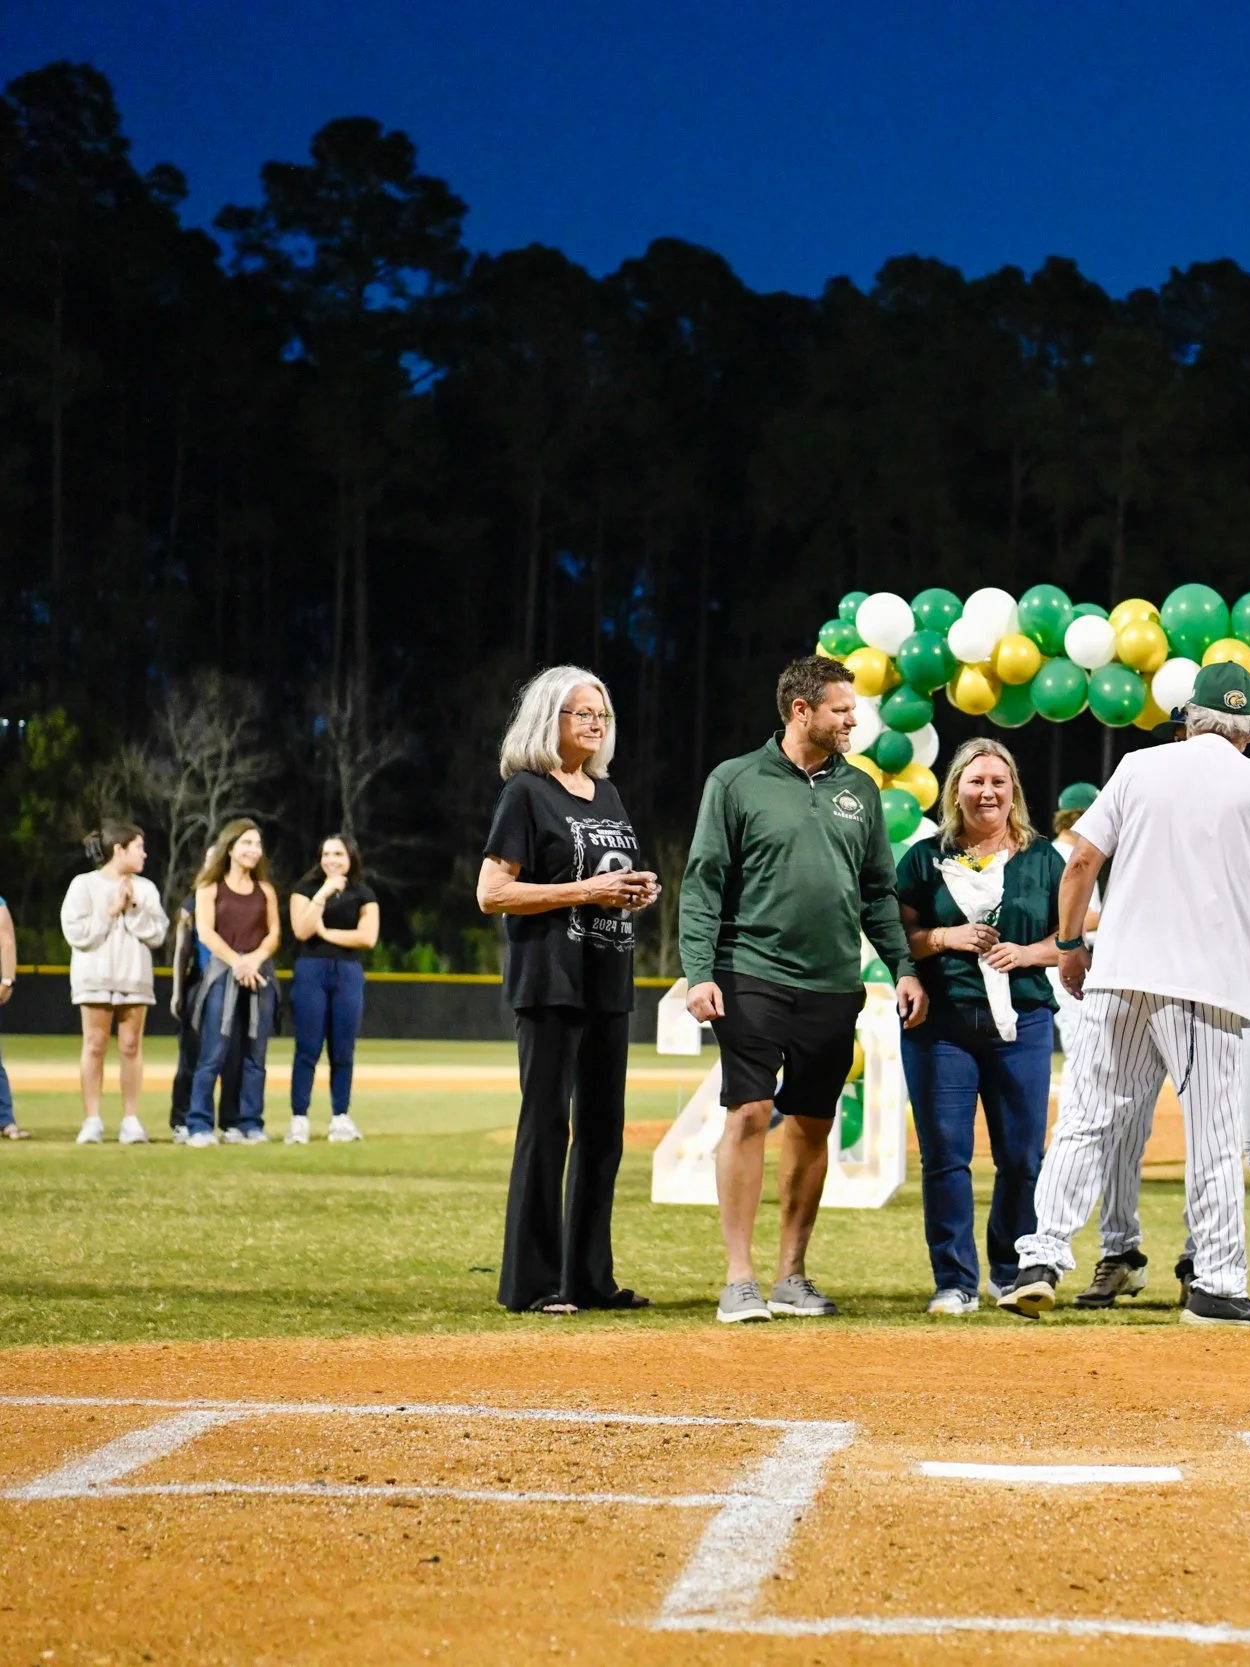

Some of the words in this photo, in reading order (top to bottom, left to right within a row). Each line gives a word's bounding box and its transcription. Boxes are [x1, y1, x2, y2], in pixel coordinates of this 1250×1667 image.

[832, 810, 863, 822] BASEBALL
[588, 832, 638, 850] STRAIT
[592, 917, 617, 933] 2024
